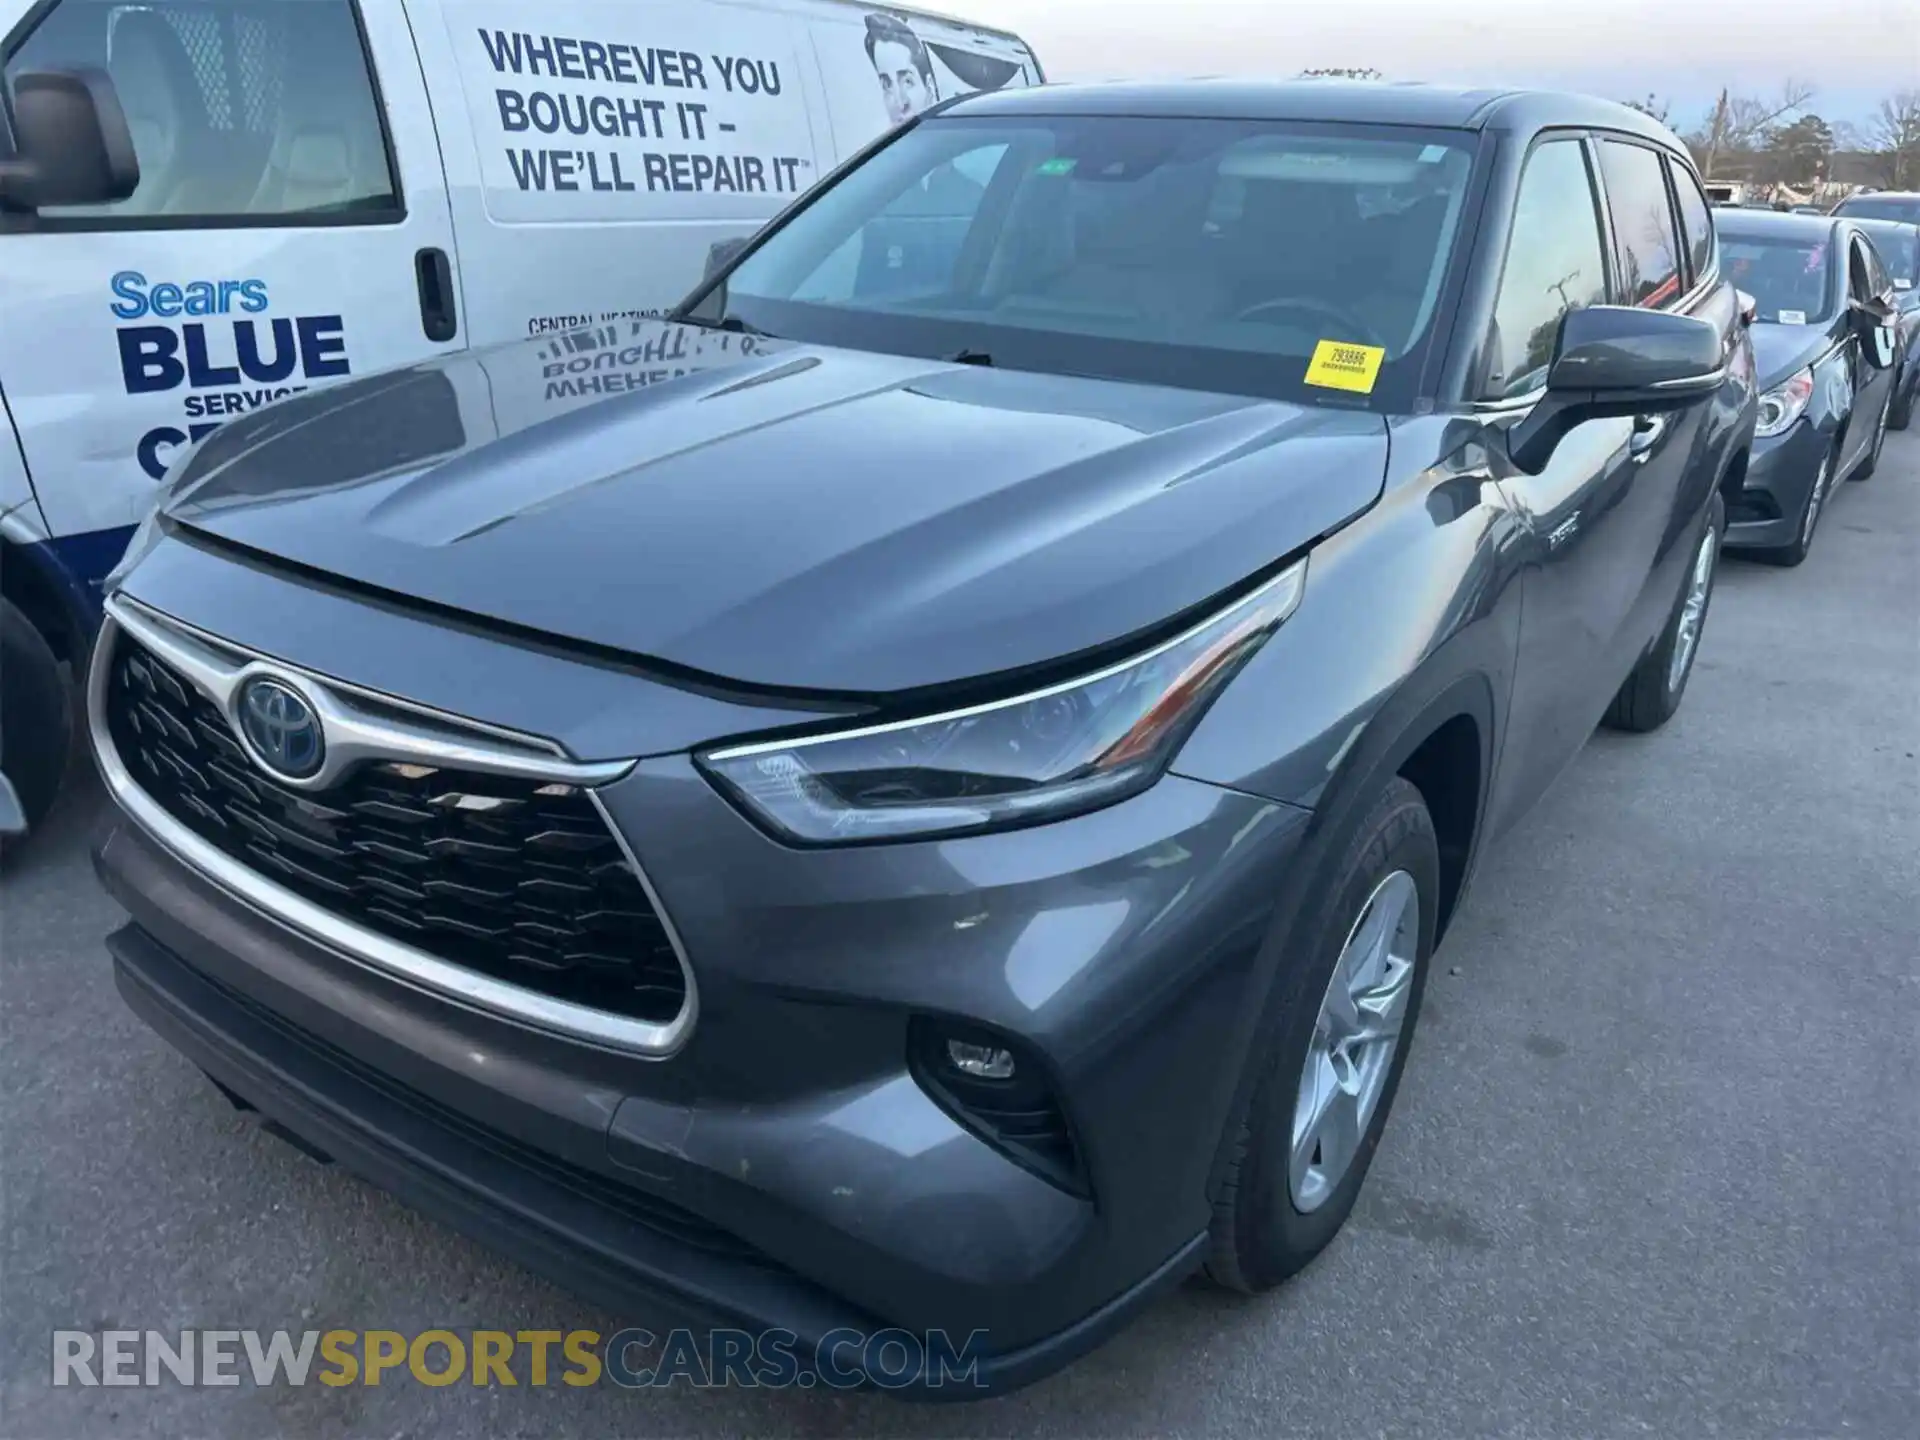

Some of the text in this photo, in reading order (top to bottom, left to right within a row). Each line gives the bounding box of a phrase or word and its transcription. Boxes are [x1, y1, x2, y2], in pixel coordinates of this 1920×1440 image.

[478, 28, 781, 96] WHEREVER YOU
[495, 89, 665, 139] BOUGHT
[676, 102, 707, 140] IT
[505, 148, 636, 192] WE'LL
[643, 153, 765, 192] REPAIR
[110, 271, 268, 320] Sears
[116, 315, 350, 394] BLUE
[183, 386, 308, 418] SERVI
